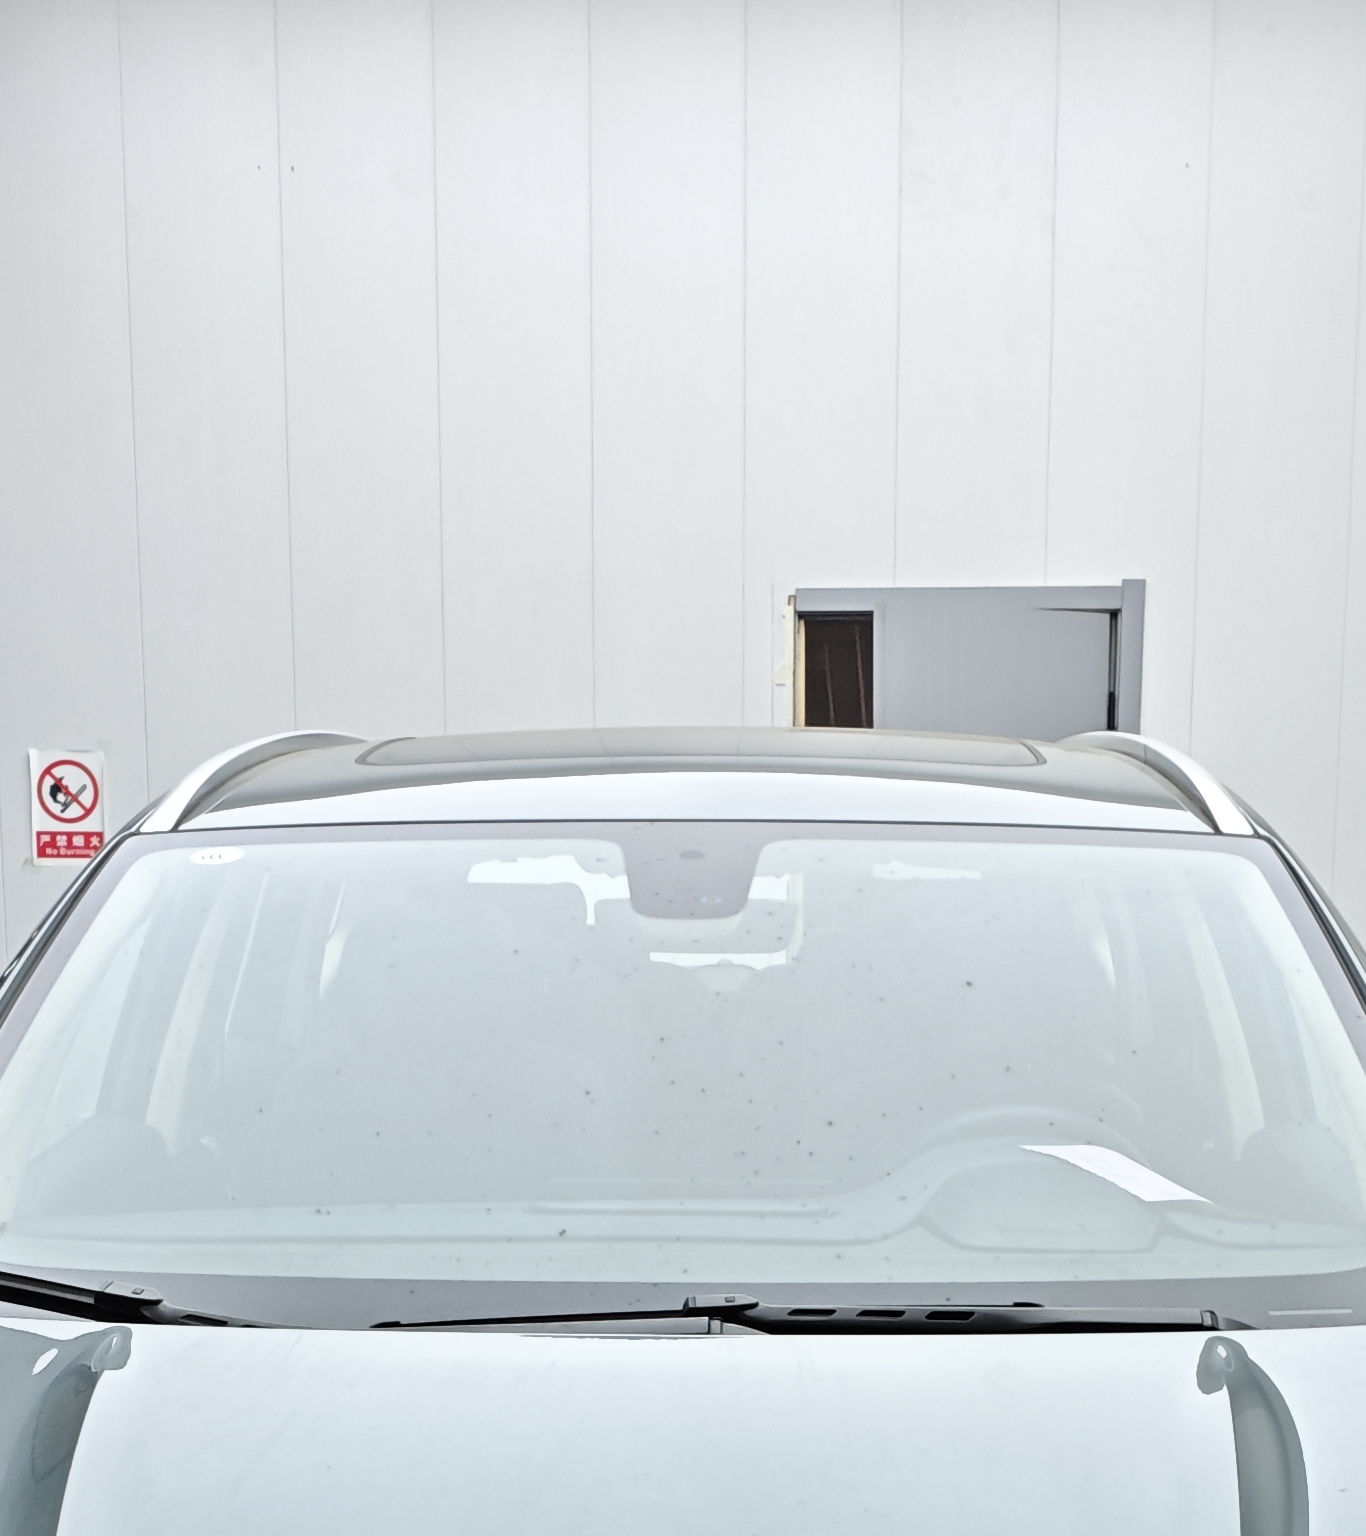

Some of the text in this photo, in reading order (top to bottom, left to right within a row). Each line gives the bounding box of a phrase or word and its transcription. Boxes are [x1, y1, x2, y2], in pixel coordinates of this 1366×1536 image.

[39, 834, 101, 847] 严禁烟火
[46, 847, 58, 856] No
